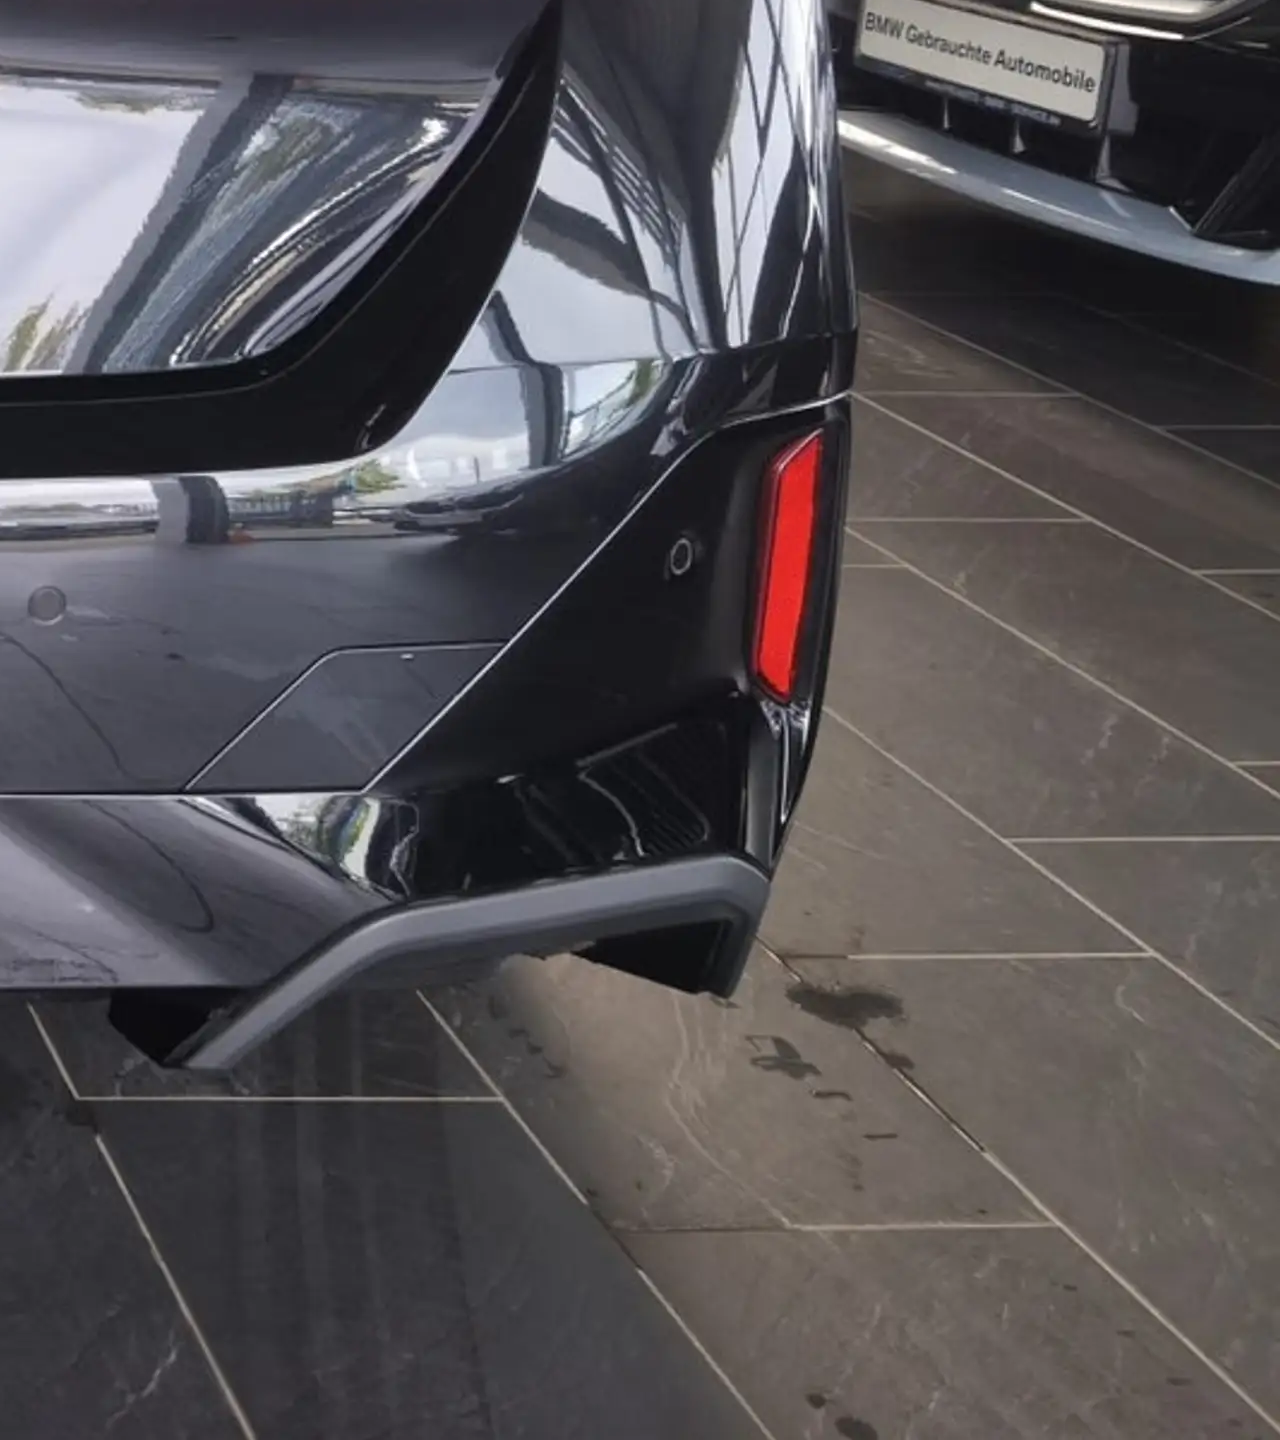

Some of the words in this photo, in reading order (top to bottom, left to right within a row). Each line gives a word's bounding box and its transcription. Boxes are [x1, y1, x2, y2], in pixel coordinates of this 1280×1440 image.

[864, 11, 905, 41] BMW
[905, 24, 992, 66] Gebrauchte
[993, 48, 1097, 93] Automobile
